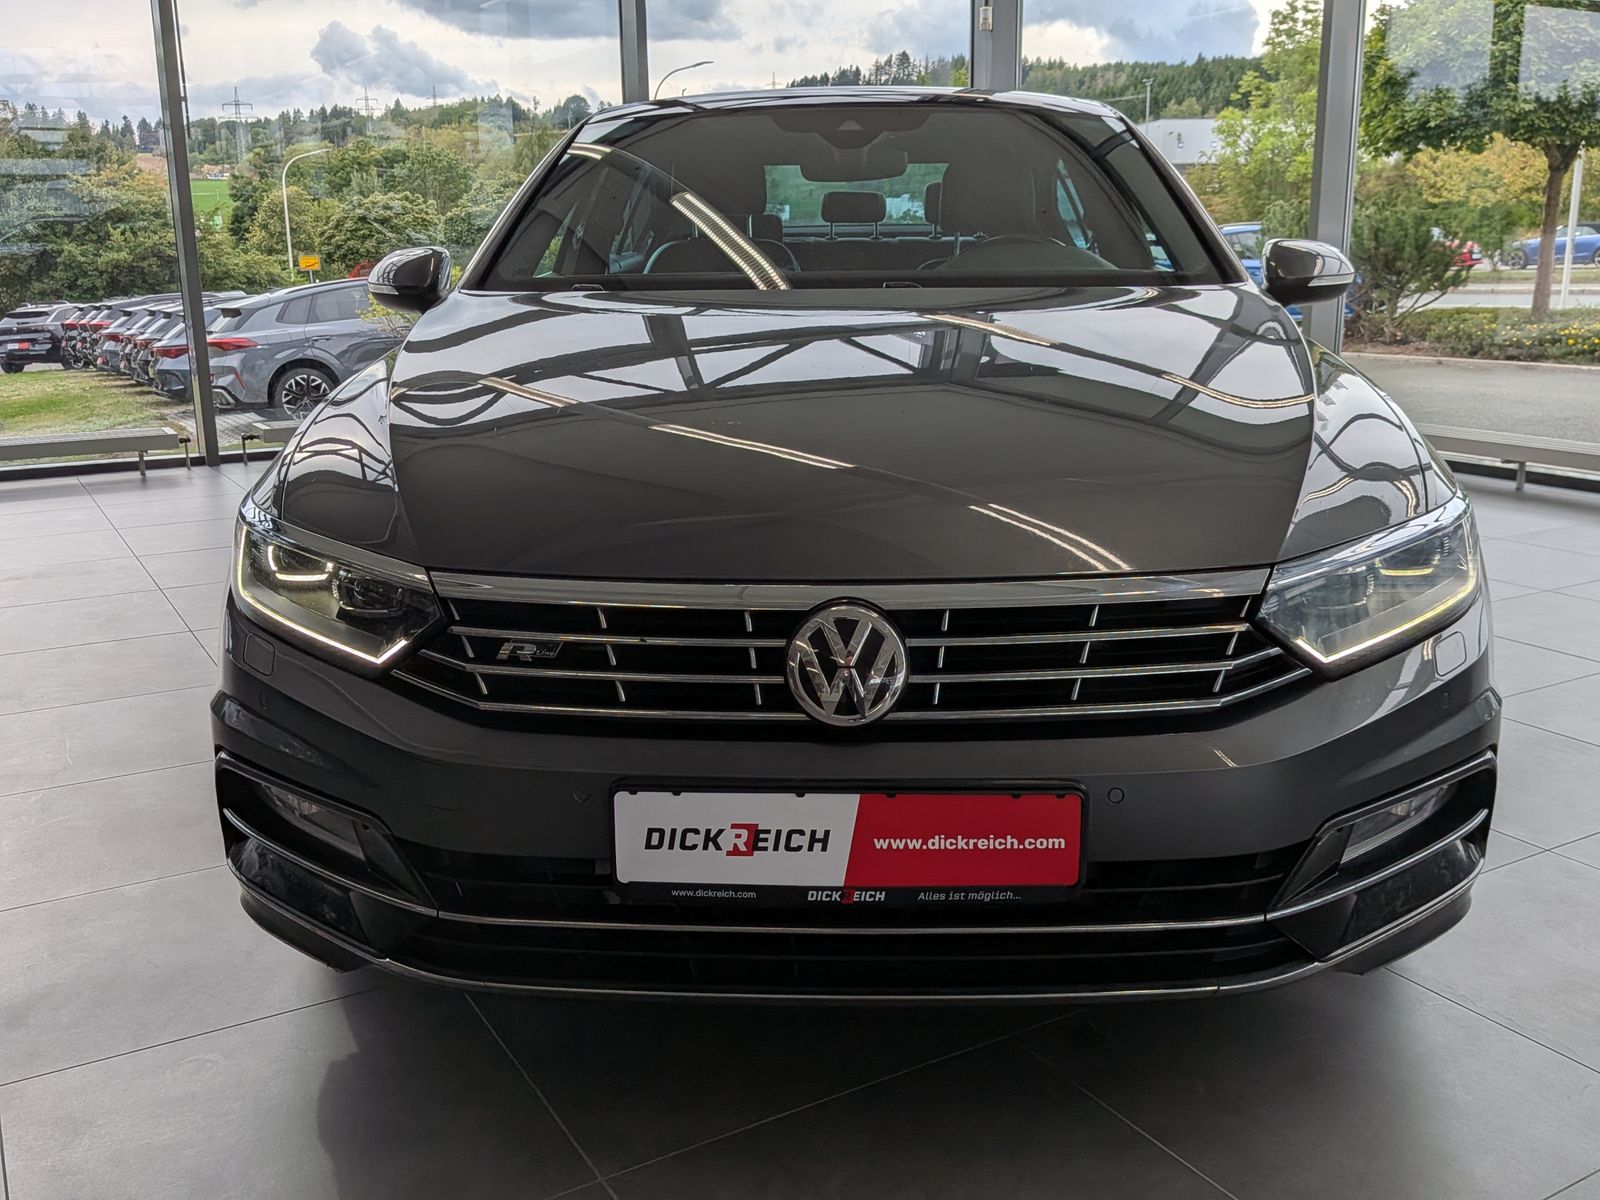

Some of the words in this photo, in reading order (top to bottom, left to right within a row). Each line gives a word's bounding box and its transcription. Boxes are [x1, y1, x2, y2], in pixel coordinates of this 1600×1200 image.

[788, 605, 907, 726] VW
[644, 825, 831, 856] DICKREICH
[874, 835, 1066, 850] www.dickreich.com
[671, 888, 757, 899] www.dickreich.com
[917, 891, 946, 901] Alles
[948, 891, 966, 901] ist
